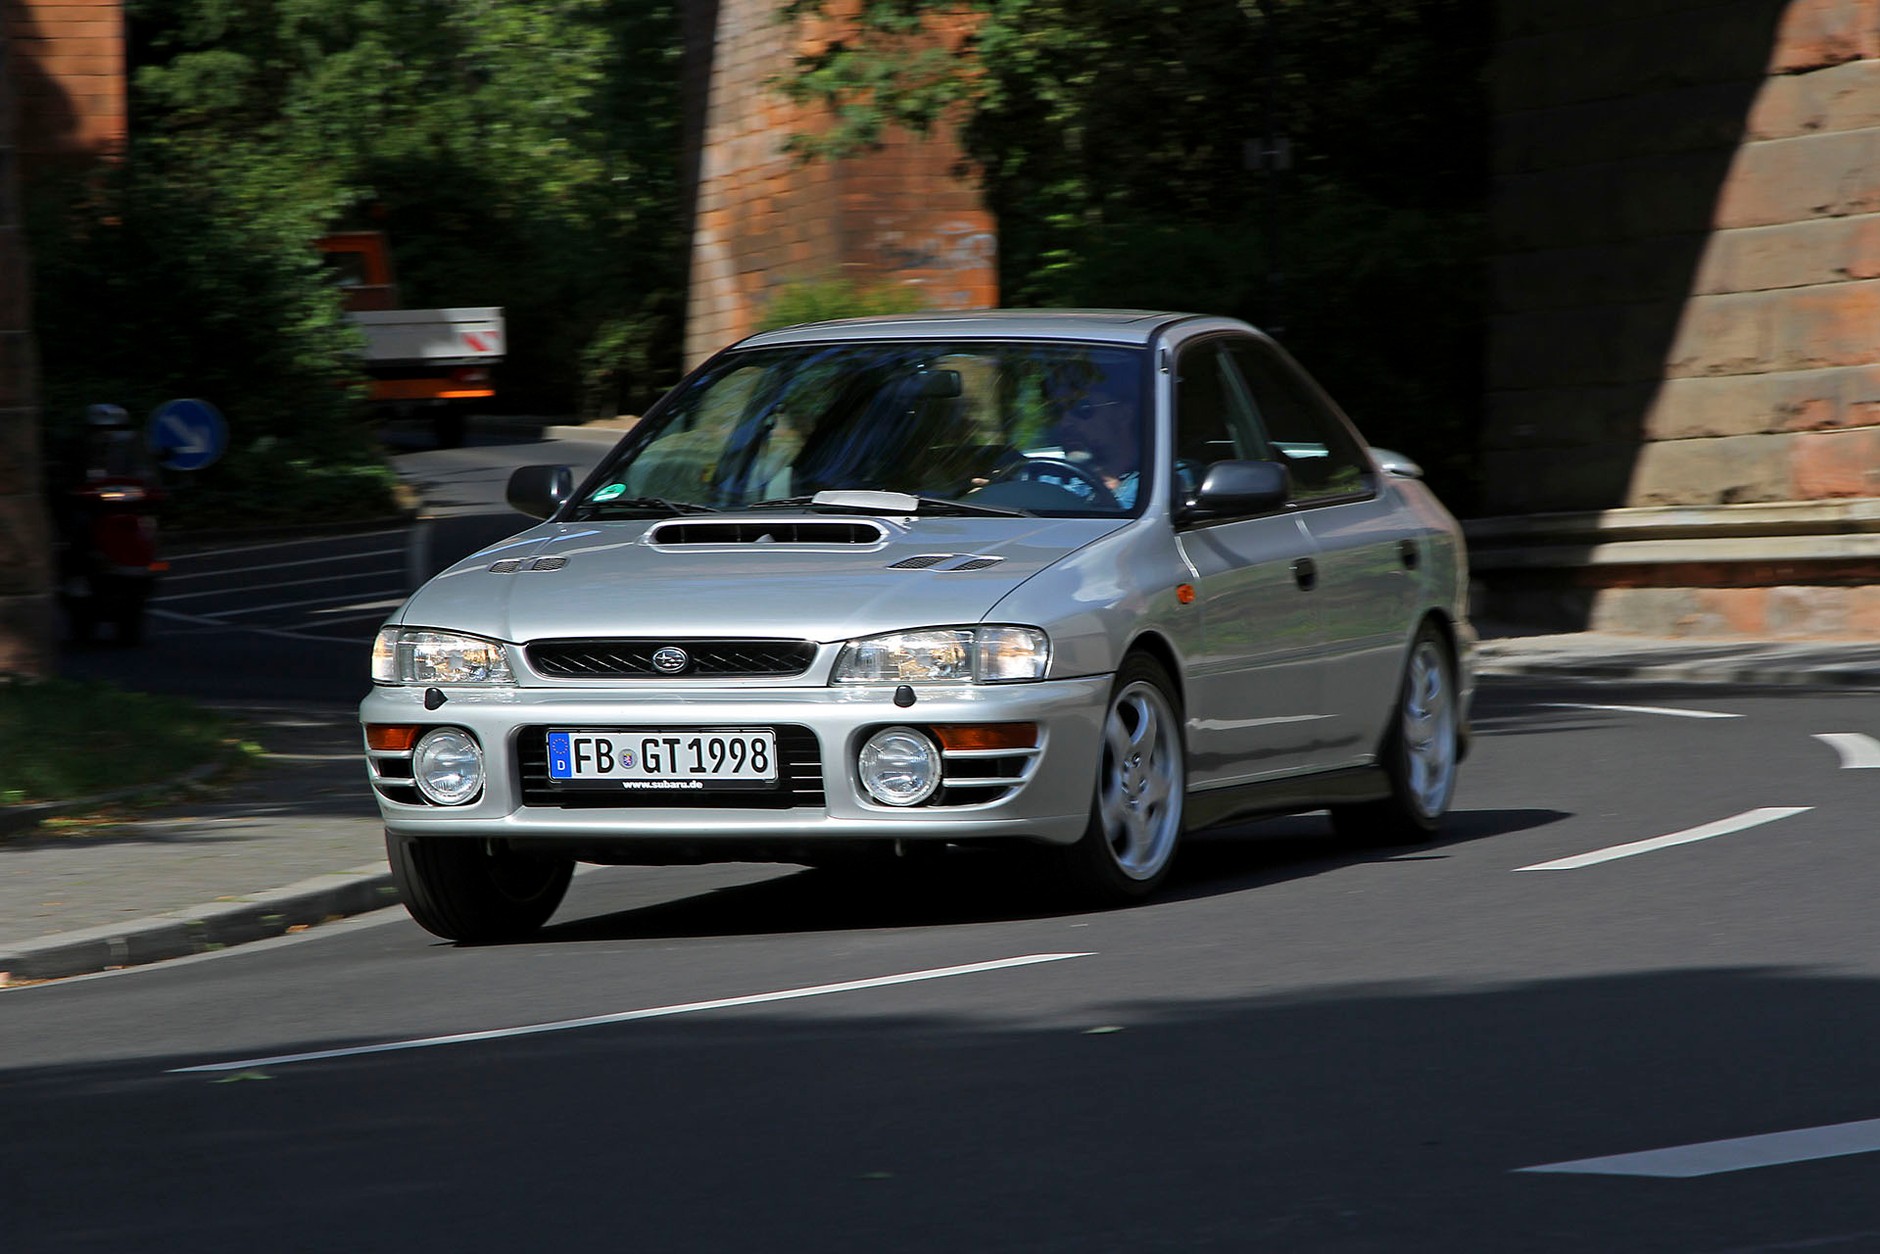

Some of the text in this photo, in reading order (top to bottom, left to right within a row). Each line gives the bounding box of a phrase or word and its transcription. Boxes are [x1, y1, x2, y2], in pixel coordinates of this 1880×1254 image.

[573, 738, 768, 774] FB GT 1998
[557, 760, 566, 770] D
[622, 780, 703, 789] www.subaru.de
